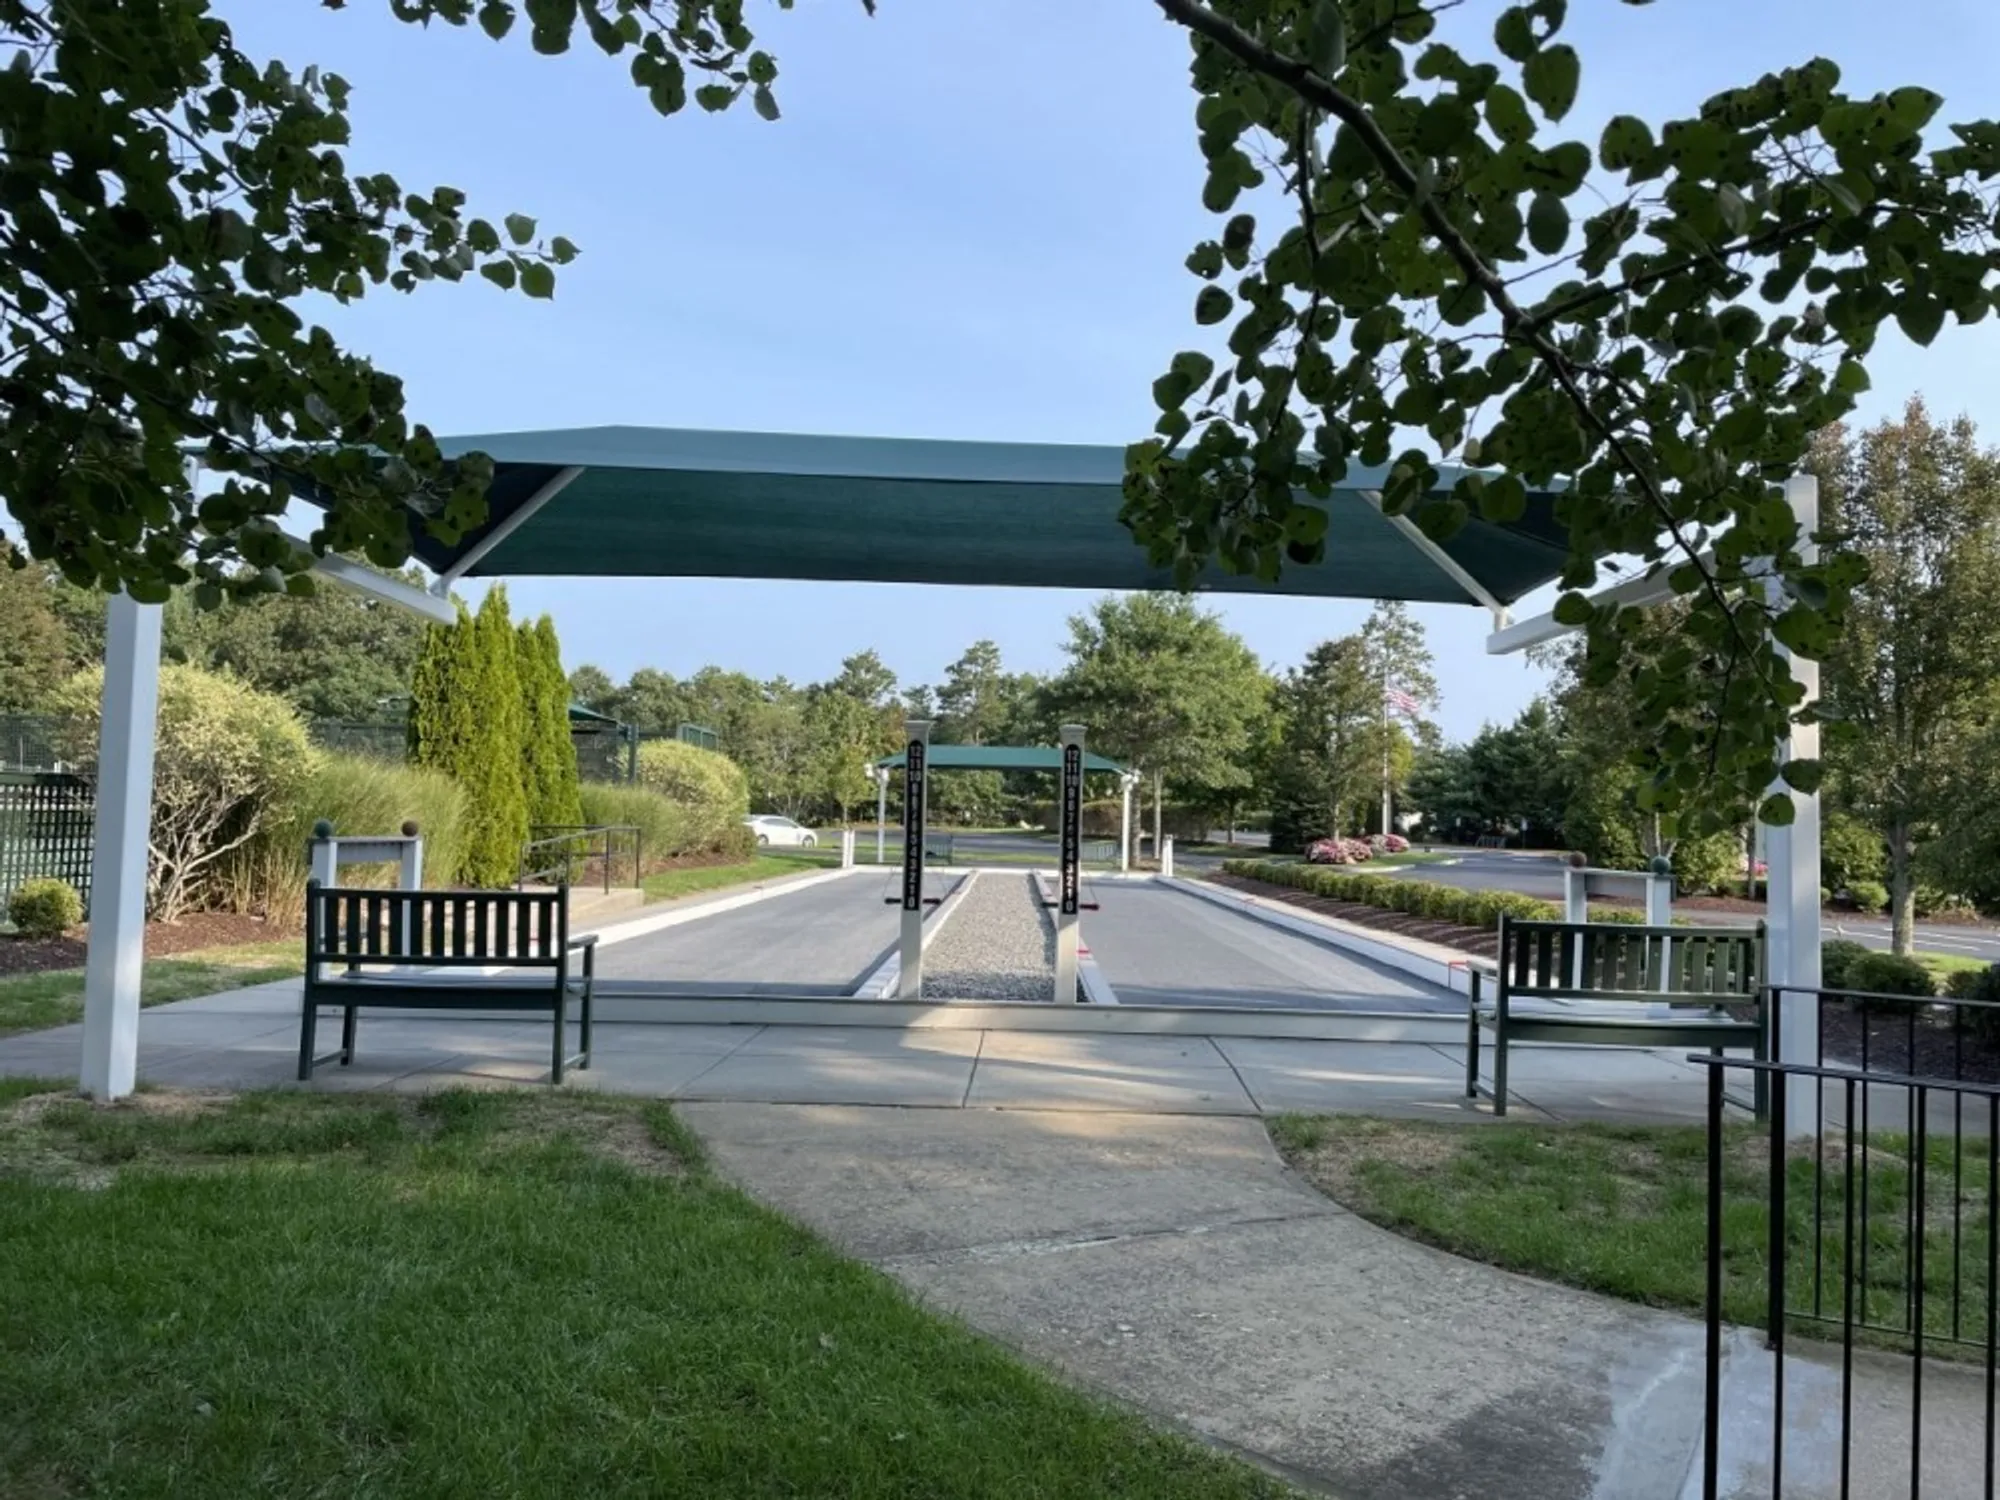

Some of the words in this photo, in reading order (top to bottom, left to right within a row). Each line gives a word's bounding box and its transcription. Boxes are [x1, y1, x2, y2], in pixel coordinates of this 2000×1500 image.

[1066, 763, 1078, 774] 11
[910, 771, 921, 782] 10
[909, 846, 918, 857] 4
[909, 872, 917, 883] 2
[1066, 875, 1074, 887] 2
[908, 896, 915, 908] 0
[1065, 900, 1073, 912] 0
